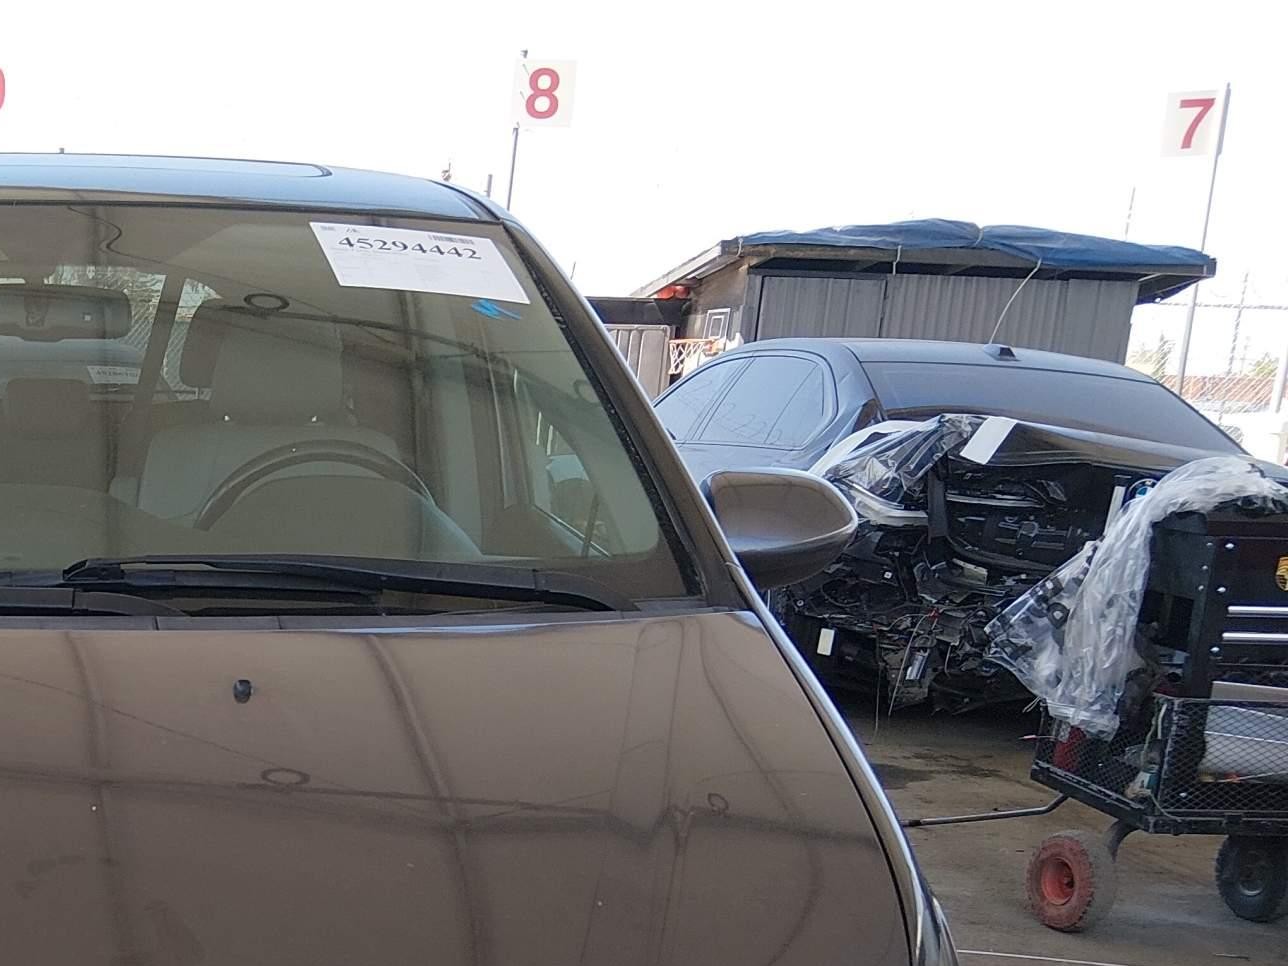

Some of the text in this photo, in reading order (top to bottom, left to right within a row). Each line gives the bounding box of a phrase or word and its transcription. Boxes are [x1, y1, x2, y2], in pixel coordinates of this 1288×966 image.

[525, 67, 561, 120] 8
[1179, 97, 1217, 150] 7
[338, 235, 482, 261] 45294442
